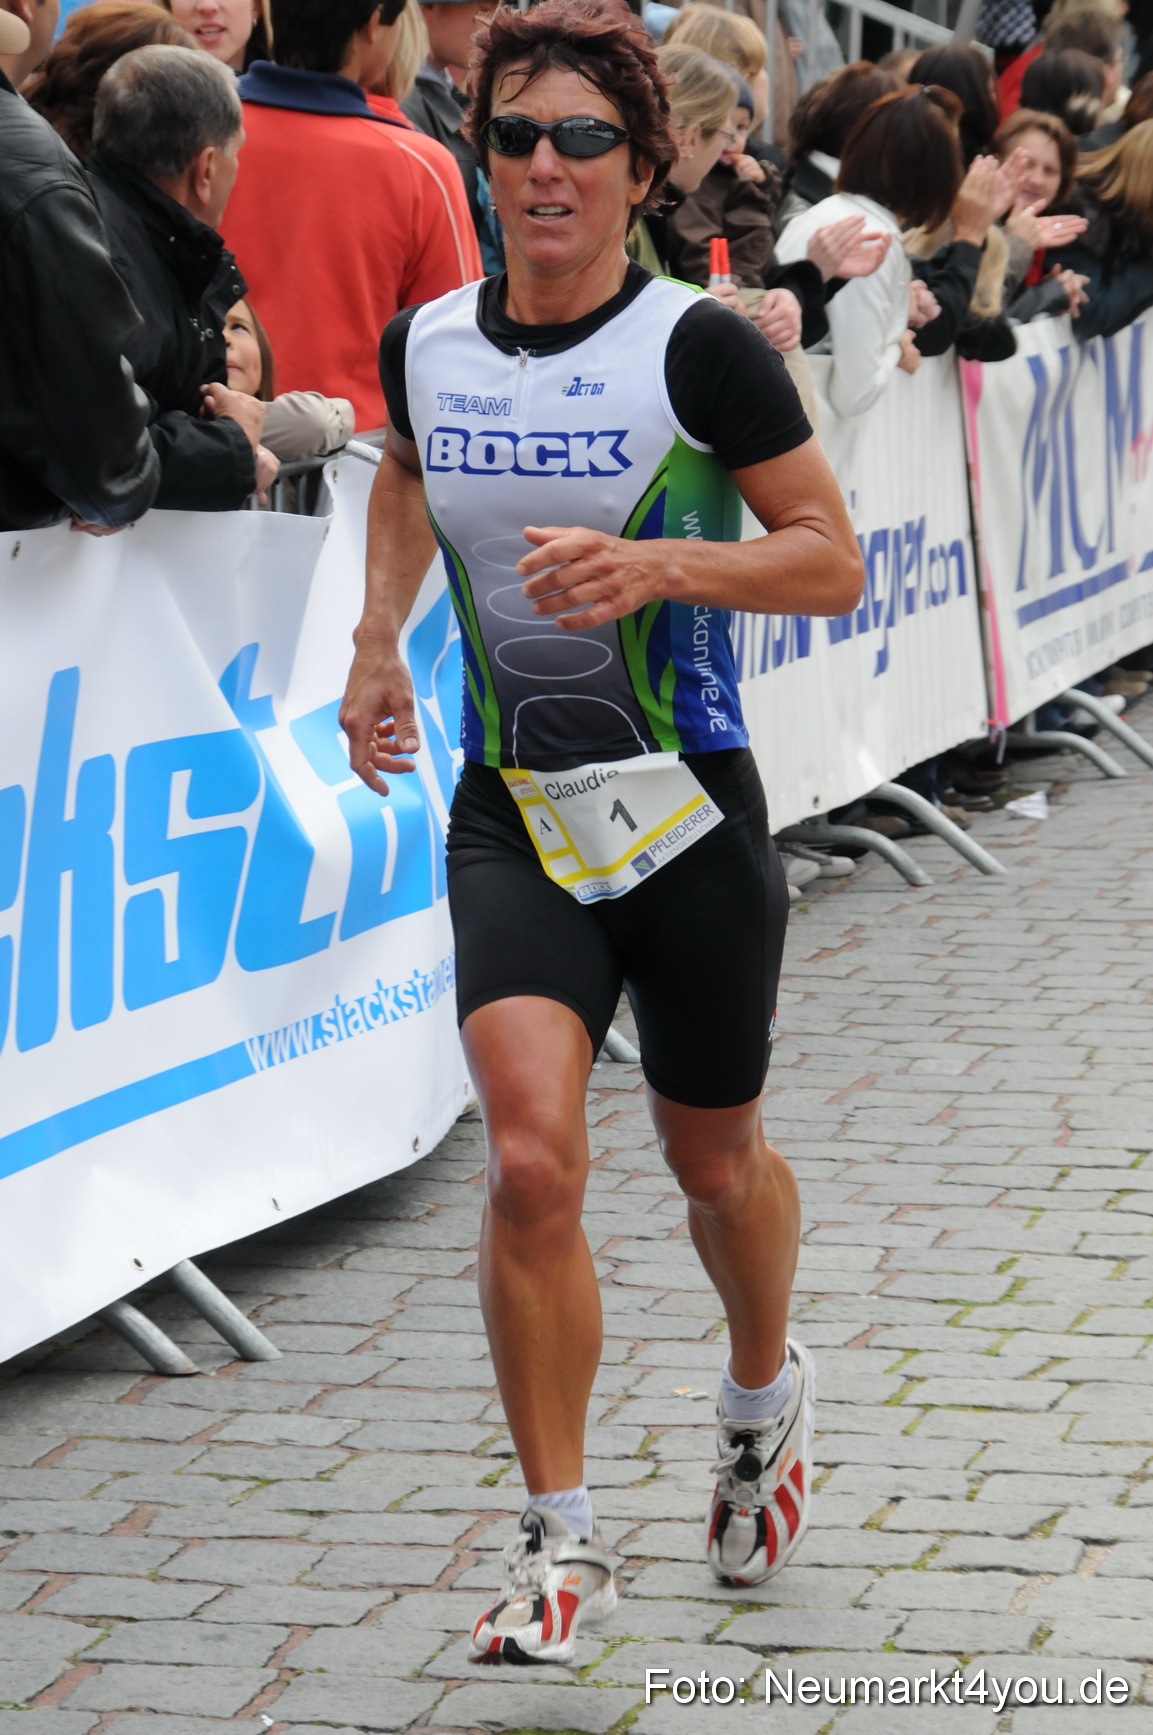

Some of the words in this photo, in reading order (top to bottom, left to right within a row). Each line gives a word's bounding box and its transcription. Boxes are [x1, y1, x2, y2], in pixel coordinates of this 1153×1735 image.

[437, 392, 513, 417] TEAM
[426, 426, 634, 478] BOCK
[540, 816, 554, 835] A
[609, 798, 638, 833] 1
[648, 804, 715, 858] PFLEIDERER
[657, 814, 720, 865] AKTIENGESELLSCHAFT
